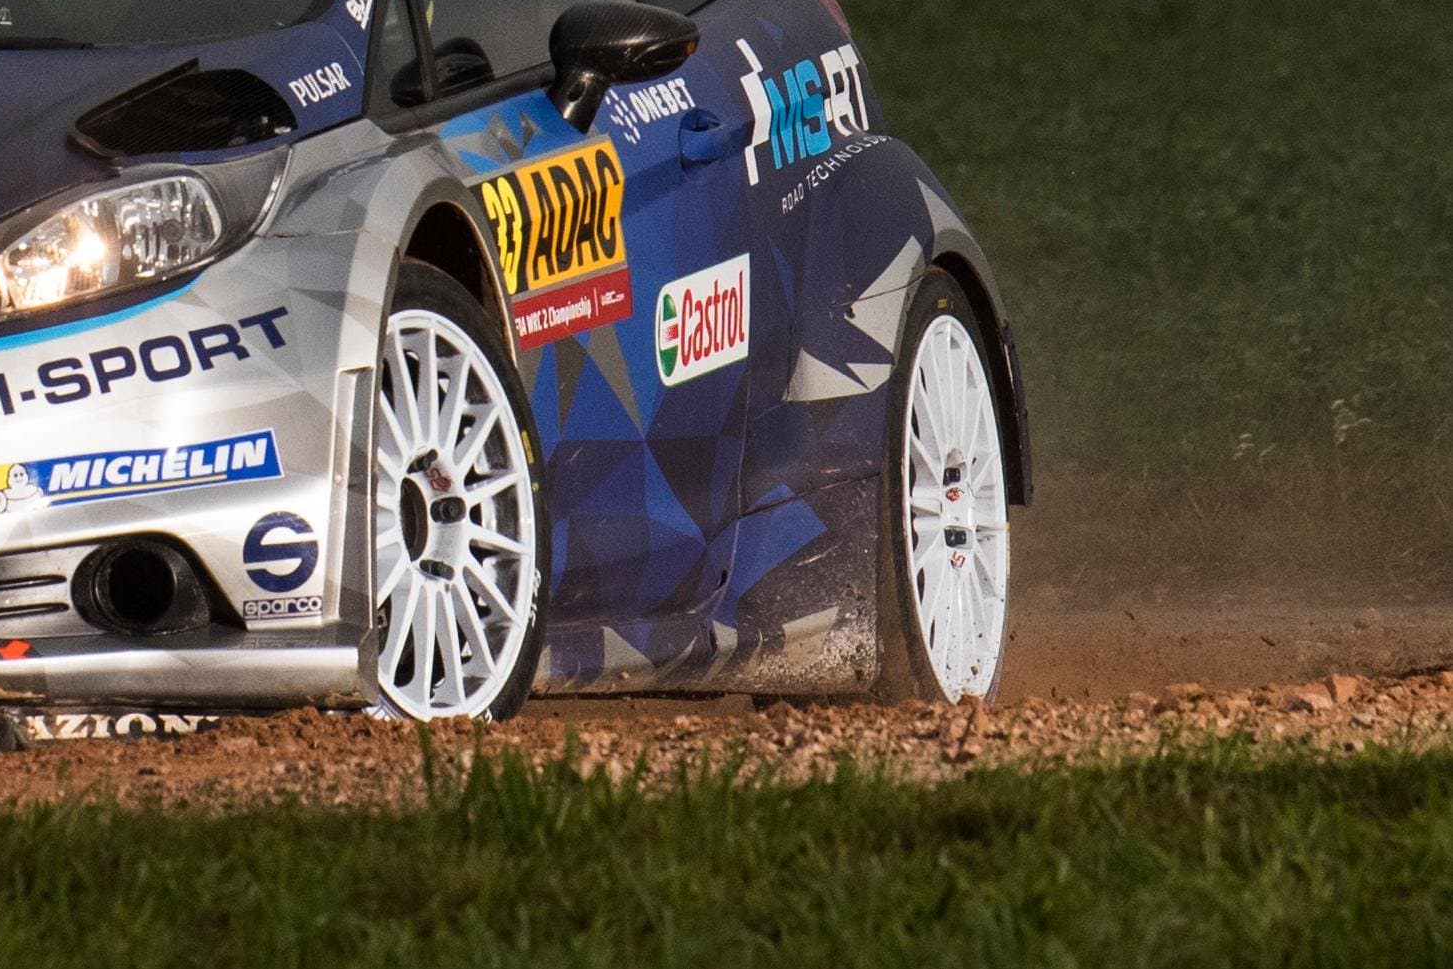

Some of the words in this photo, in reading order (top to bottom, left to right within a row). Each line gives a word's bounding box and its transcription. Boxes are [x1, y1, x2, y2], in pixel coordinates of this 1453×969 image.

[288, 62, 351, 108] PULSAR
[628, 77, 695, 124] ONEBET
[533, 148, 621, 282] ADAC
[781, 181, 805, 215] ROAD
[680, 271, 745, 368] Castrol
[49, 437, 267, 494] MICHELIN
[244, 596, 322, 617] sparco
